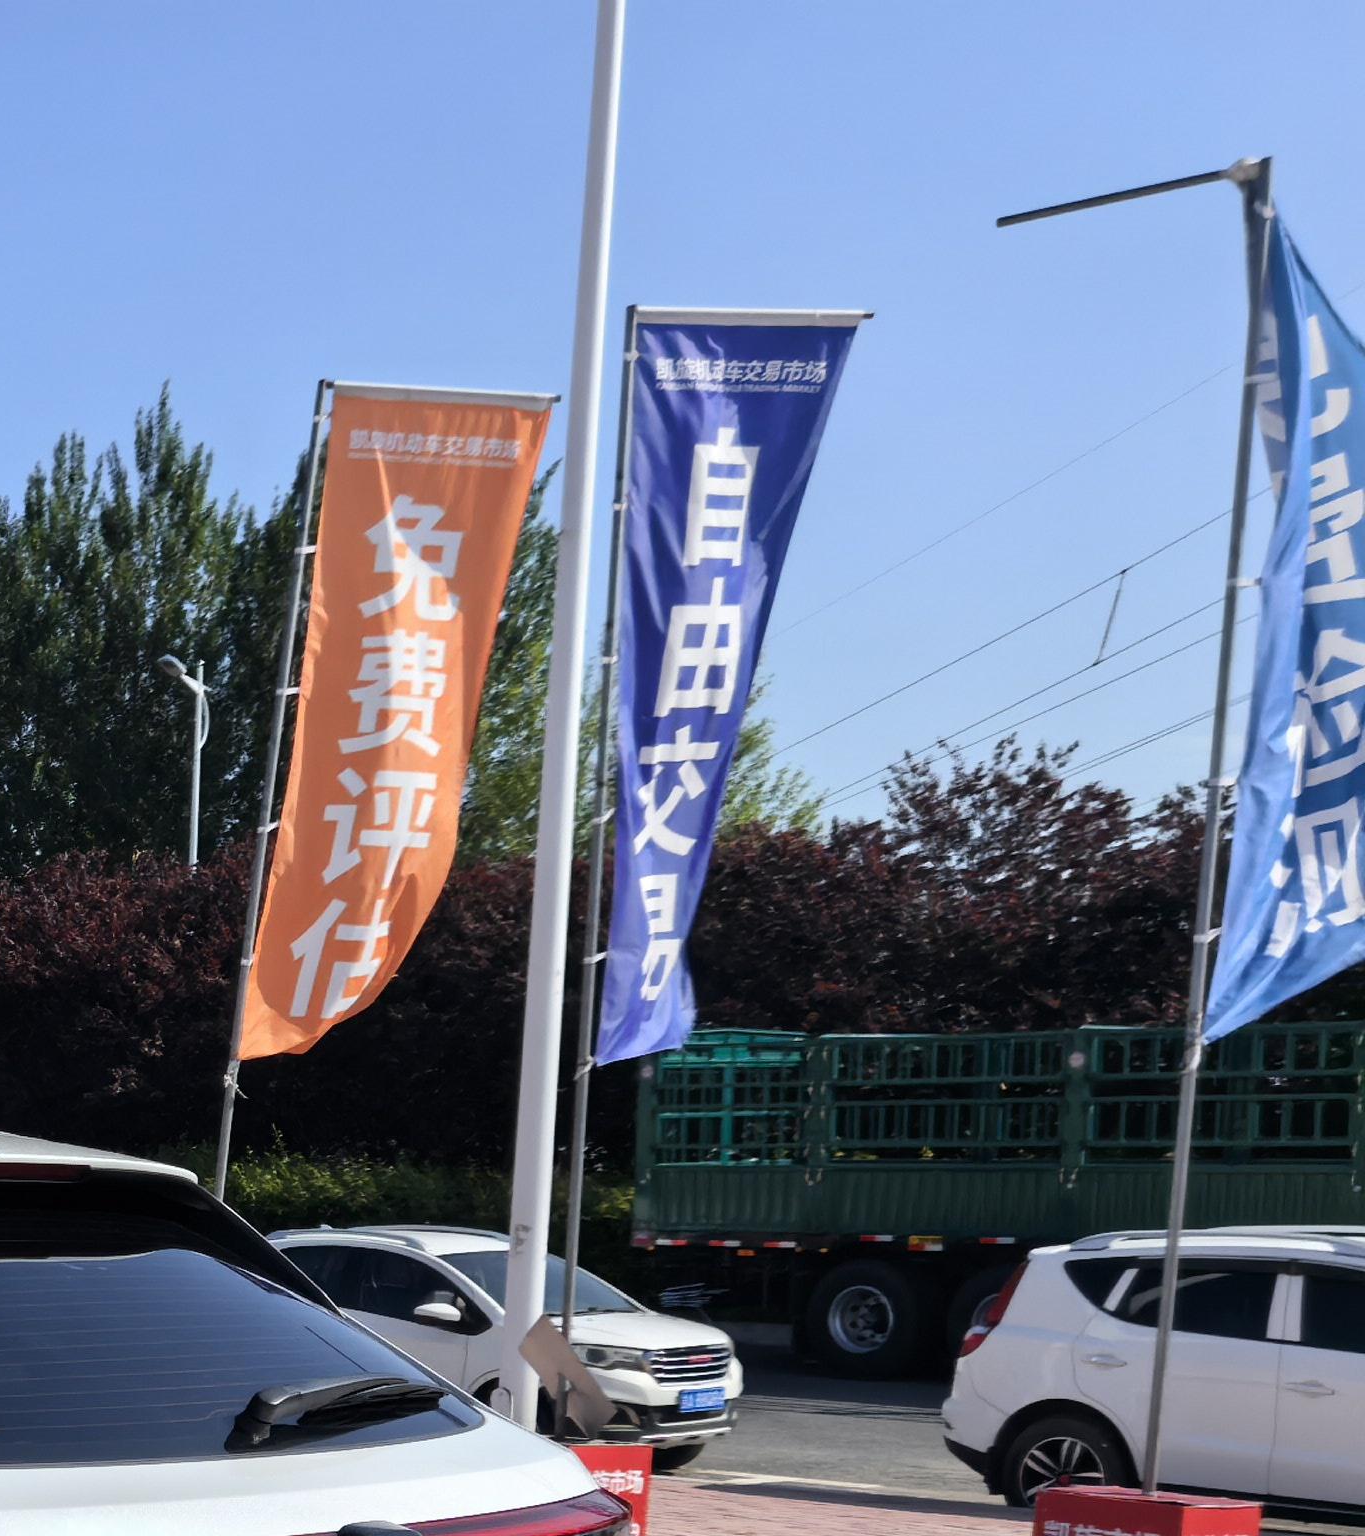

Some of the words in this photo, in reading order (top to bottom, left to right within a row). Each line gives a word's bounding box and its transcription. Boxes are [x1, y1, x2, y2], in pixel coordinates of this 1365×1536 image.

[655, 357, 828, 384] 凯旋机动车交易市场
[289, 493, 463, 1020] 免费评估
[634, 426, 761, 1002] 自由交易
[591, 1470, 645, 1494] 旋市场
